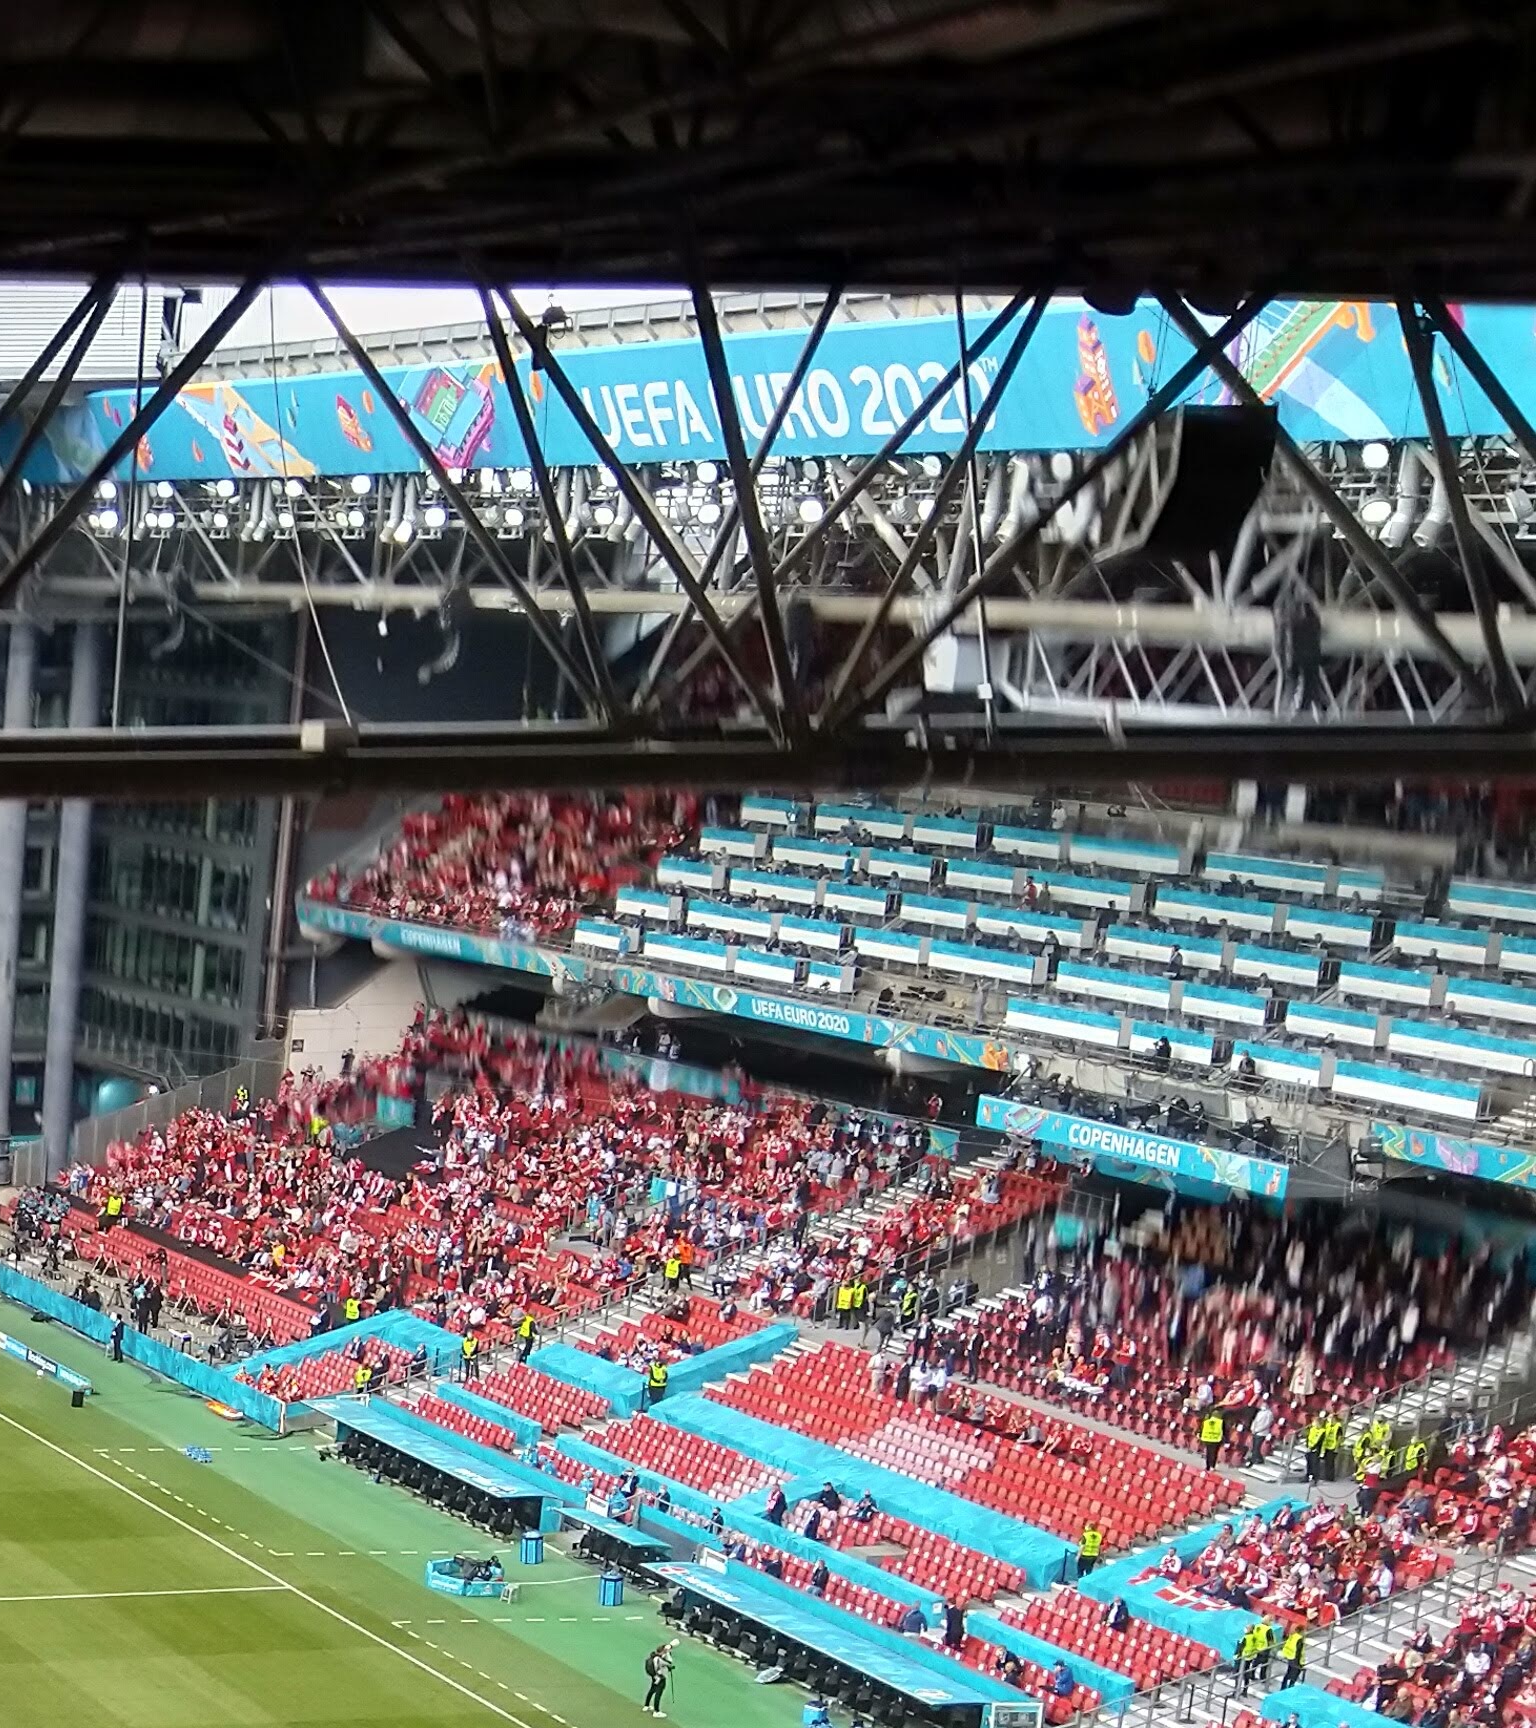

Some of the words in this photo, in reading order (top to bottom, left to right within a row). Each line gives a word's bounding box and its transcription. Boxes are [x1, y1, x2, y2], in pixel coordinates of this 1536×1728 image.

[582, 379, 714, 449] UEFA
[707, 368, 850, 440] URO
[751, 998, 783, 1020] UEFA
[783, 1007, 817, 1027] EURO
[817, 1012, 850, 1034] 2020
[1068, 1123, 1181, 1168] COPENHAGEN
